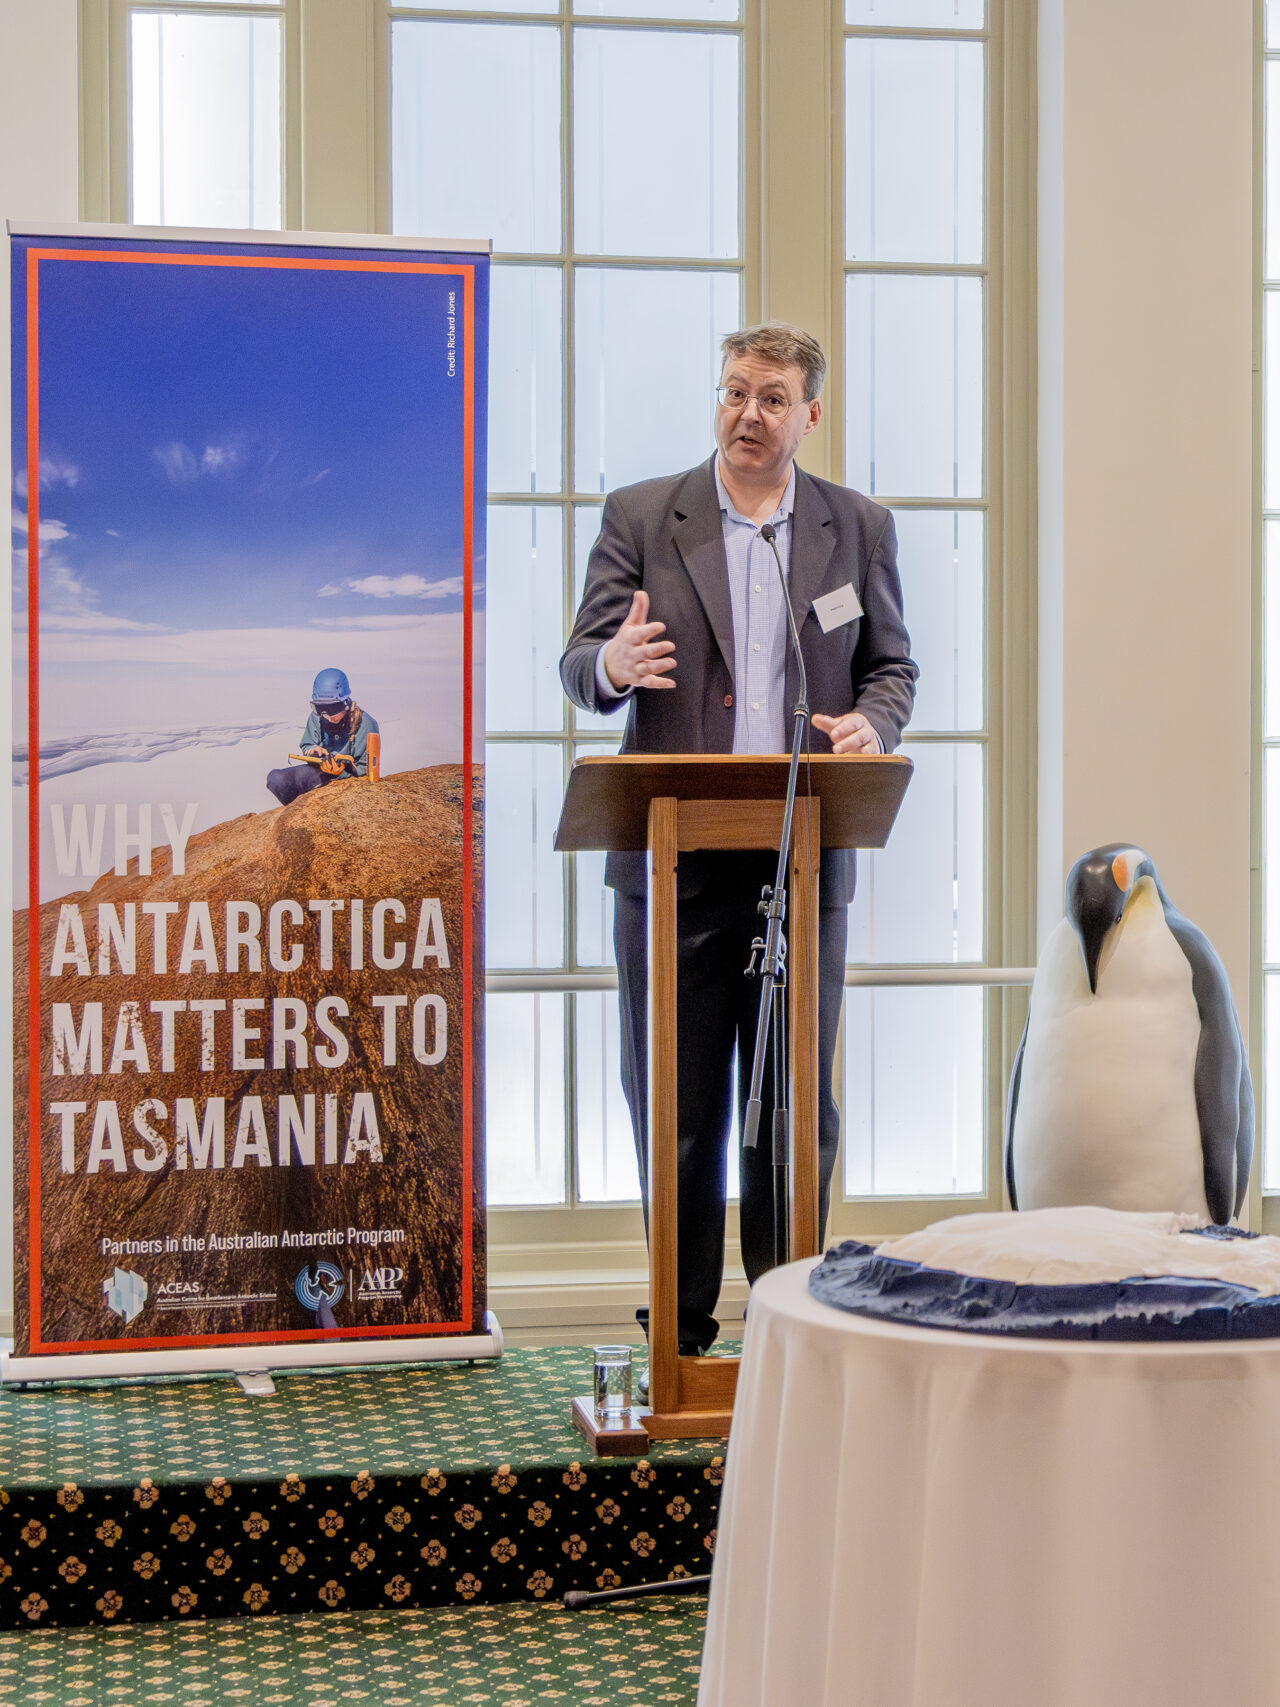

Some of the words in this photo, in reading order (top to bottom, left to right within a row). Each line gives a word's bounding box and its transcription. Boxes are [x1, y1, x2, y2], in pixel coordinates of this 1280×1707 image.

[448, 291, 456, 315] Jones
[447, 316, 456, 348] Richard
[447, 349, 456, 377] Credit:
[49, 802, 200, 878] WHY
[49, 898, 452, 977] ANTARCTICA
[51, 996, 350, 1076] MATTERS
[372, 994, 448, 1067] TO
[49, 1092, 384, 1174] TASMANIA
[102, 1237, 163, 1255] Partners
[165, 1236, 179, 1252] in
[182, 1235, 206, 1251] the
[208, 1231, 278, 1250] Australian
[281, 1228, 345, 1247] Antarctic
[347, 1227, 405, 1248] Program
[156, 1281, 200, 1294] ACEAS
[357, 1267, 404, 1291] AAPP
